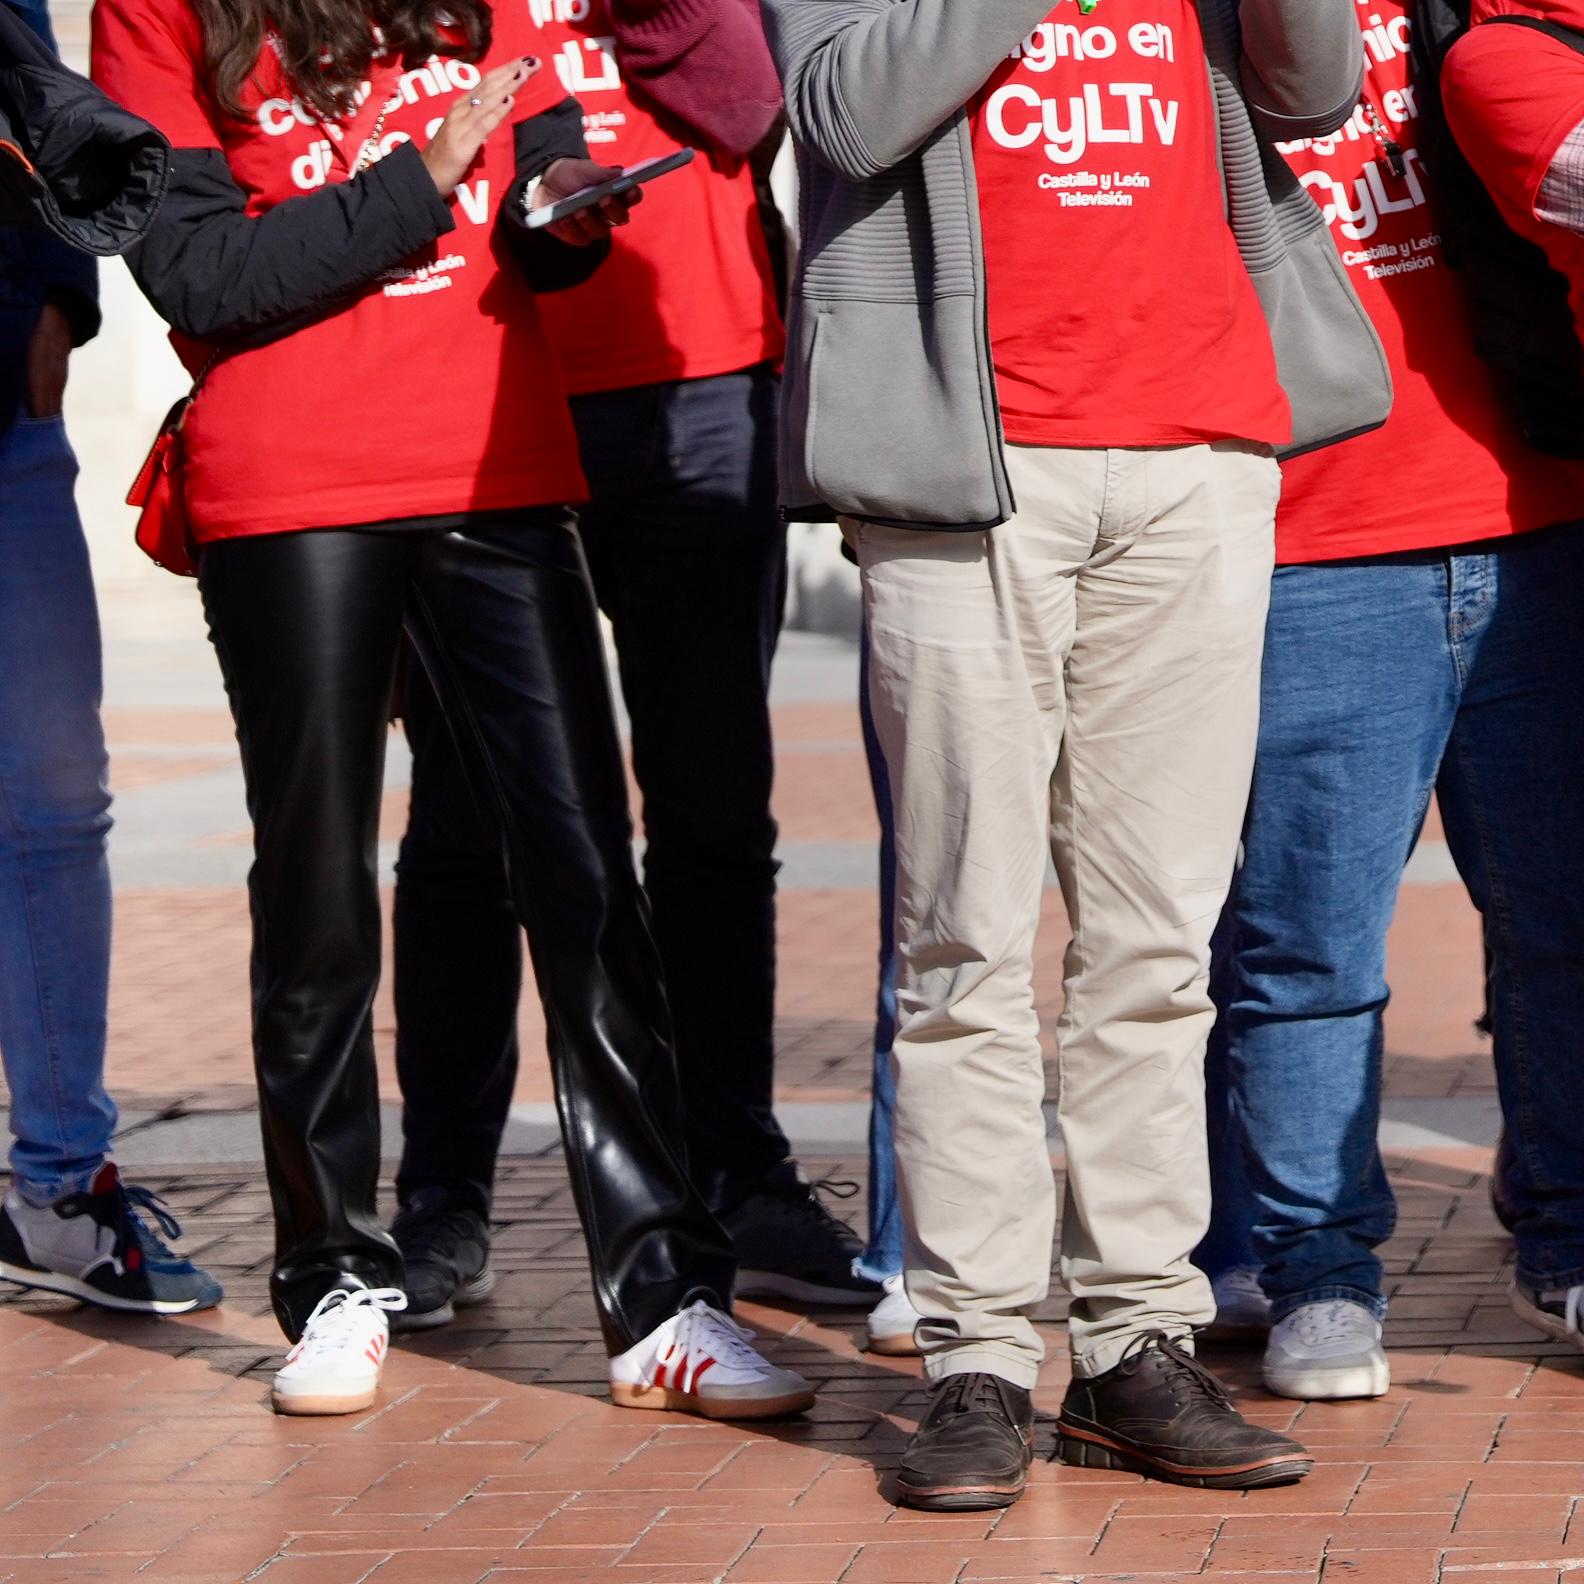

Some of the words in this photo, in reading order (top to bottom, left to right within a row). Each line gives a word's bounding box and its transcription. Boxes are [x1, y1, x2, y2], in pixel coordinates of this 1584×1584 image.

[1127, 22, 1174, 63] en
[985, 82, 1180, 165] CyLTv
[1038, 171, 1098, 190] Castilla
[1100, 175, 1111, 191] y
[1114, 171, 1150, 189] León
[1298, 147, 1430, 241] CyLT
[1057, 190, 1133, 208] Televisión
[1342, 243, 1398, 268] Castilla
[1400, 238, 1410, 257] y
[1364, 255, 1435, 281] Televisión
